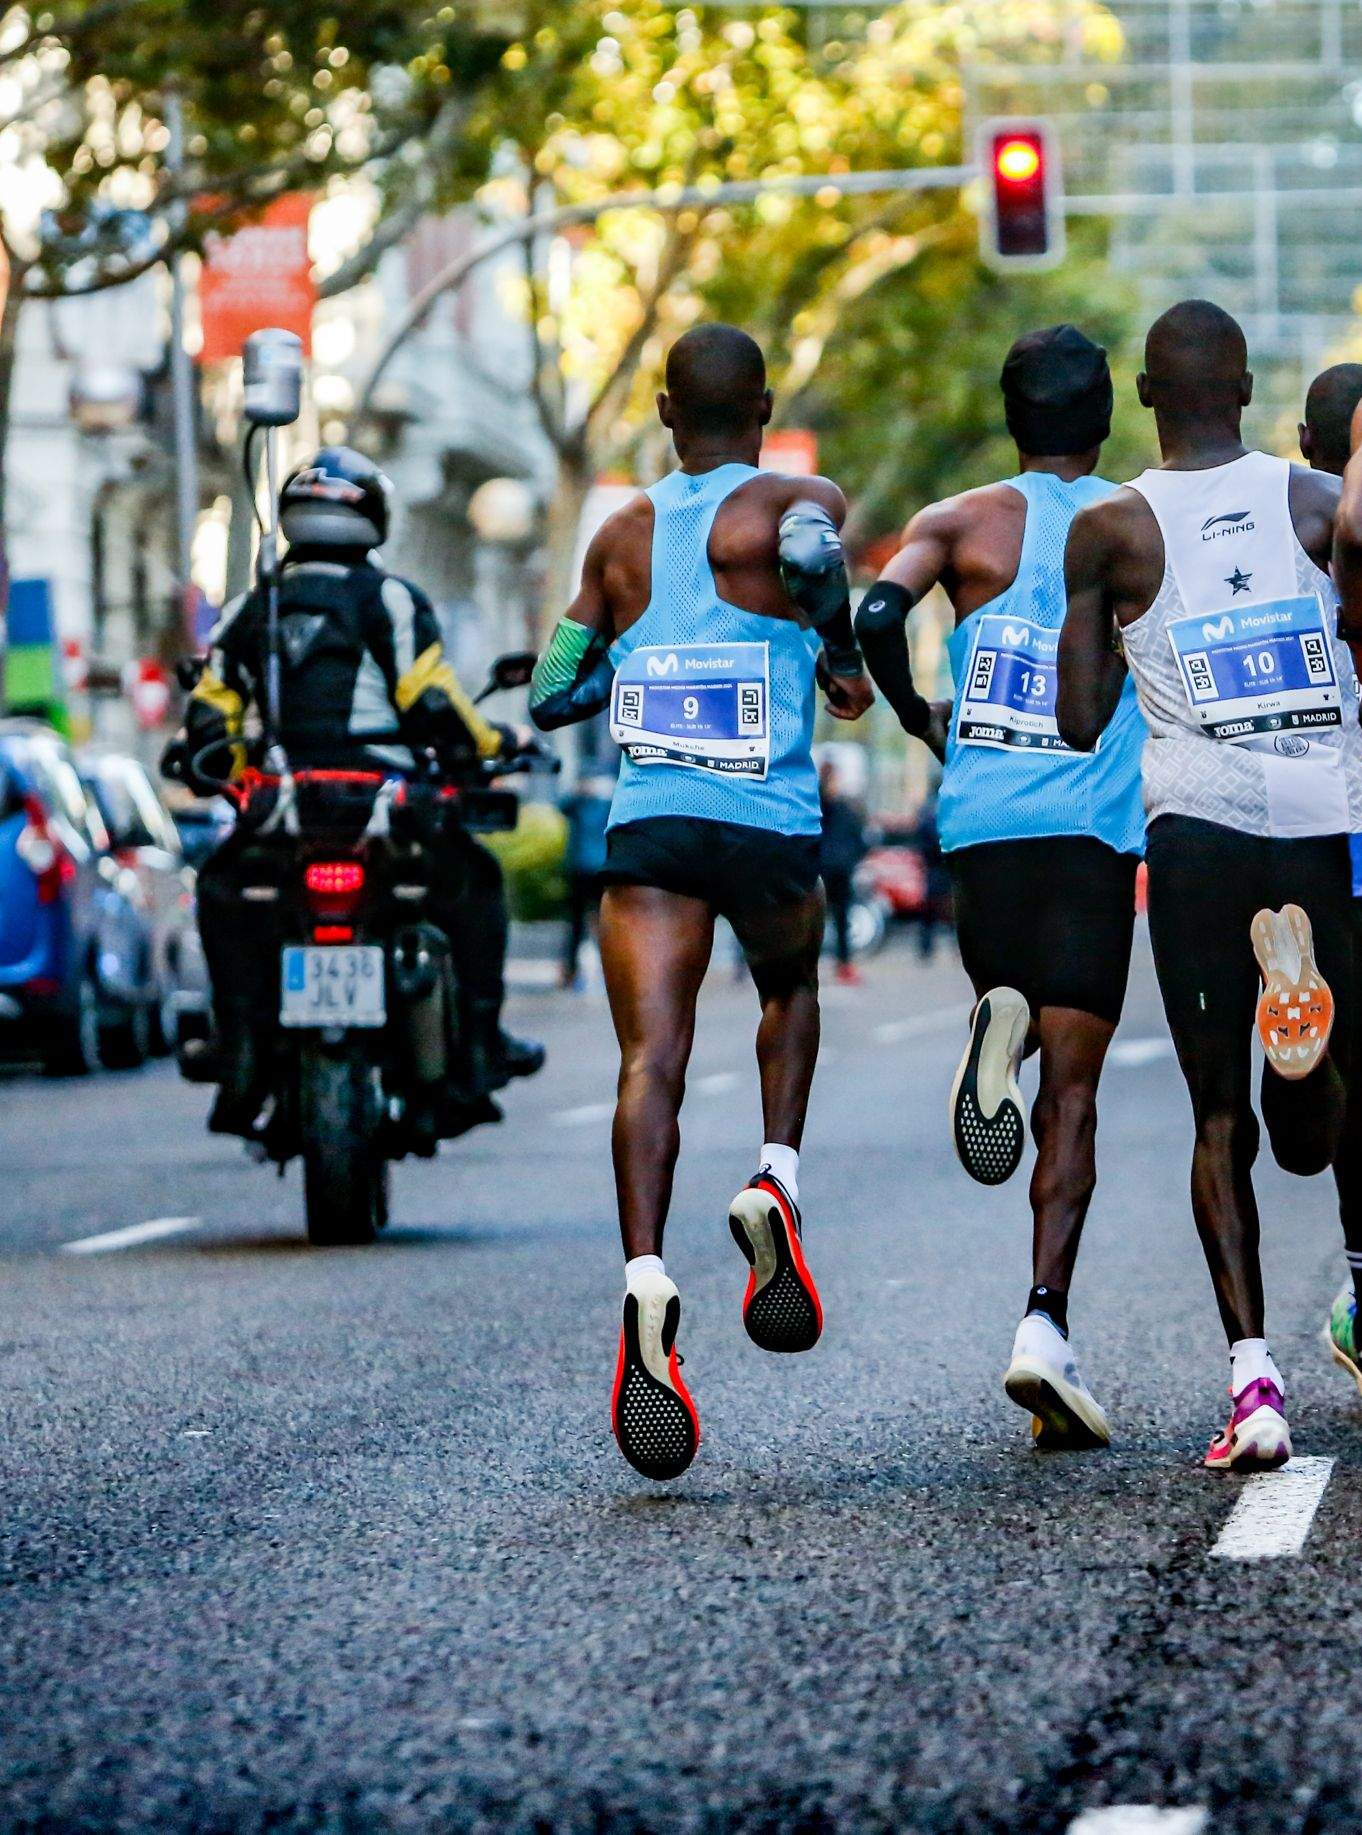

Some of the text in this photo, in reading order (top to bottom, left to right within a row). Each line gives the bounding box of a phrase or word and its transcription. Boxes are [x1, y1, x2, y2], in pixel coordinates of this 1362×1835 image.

[1203, 522, 1255, 541] LI-NING
[1240, 611, 1293, 629] Movistar
[685, 657, 735, 670] Movistar
[1242, 651, 1275, 677] 10
[1020, 671, 1046, 697] 13
[683, 695, 700, 720] 9
[1256, 700, 1281, 710] Kirwa
[1009, 715, 1044, 728] Kiprotich
[1302, 711, 1337, 723] MADRID
[719, 760, 760, 770] MADRID
